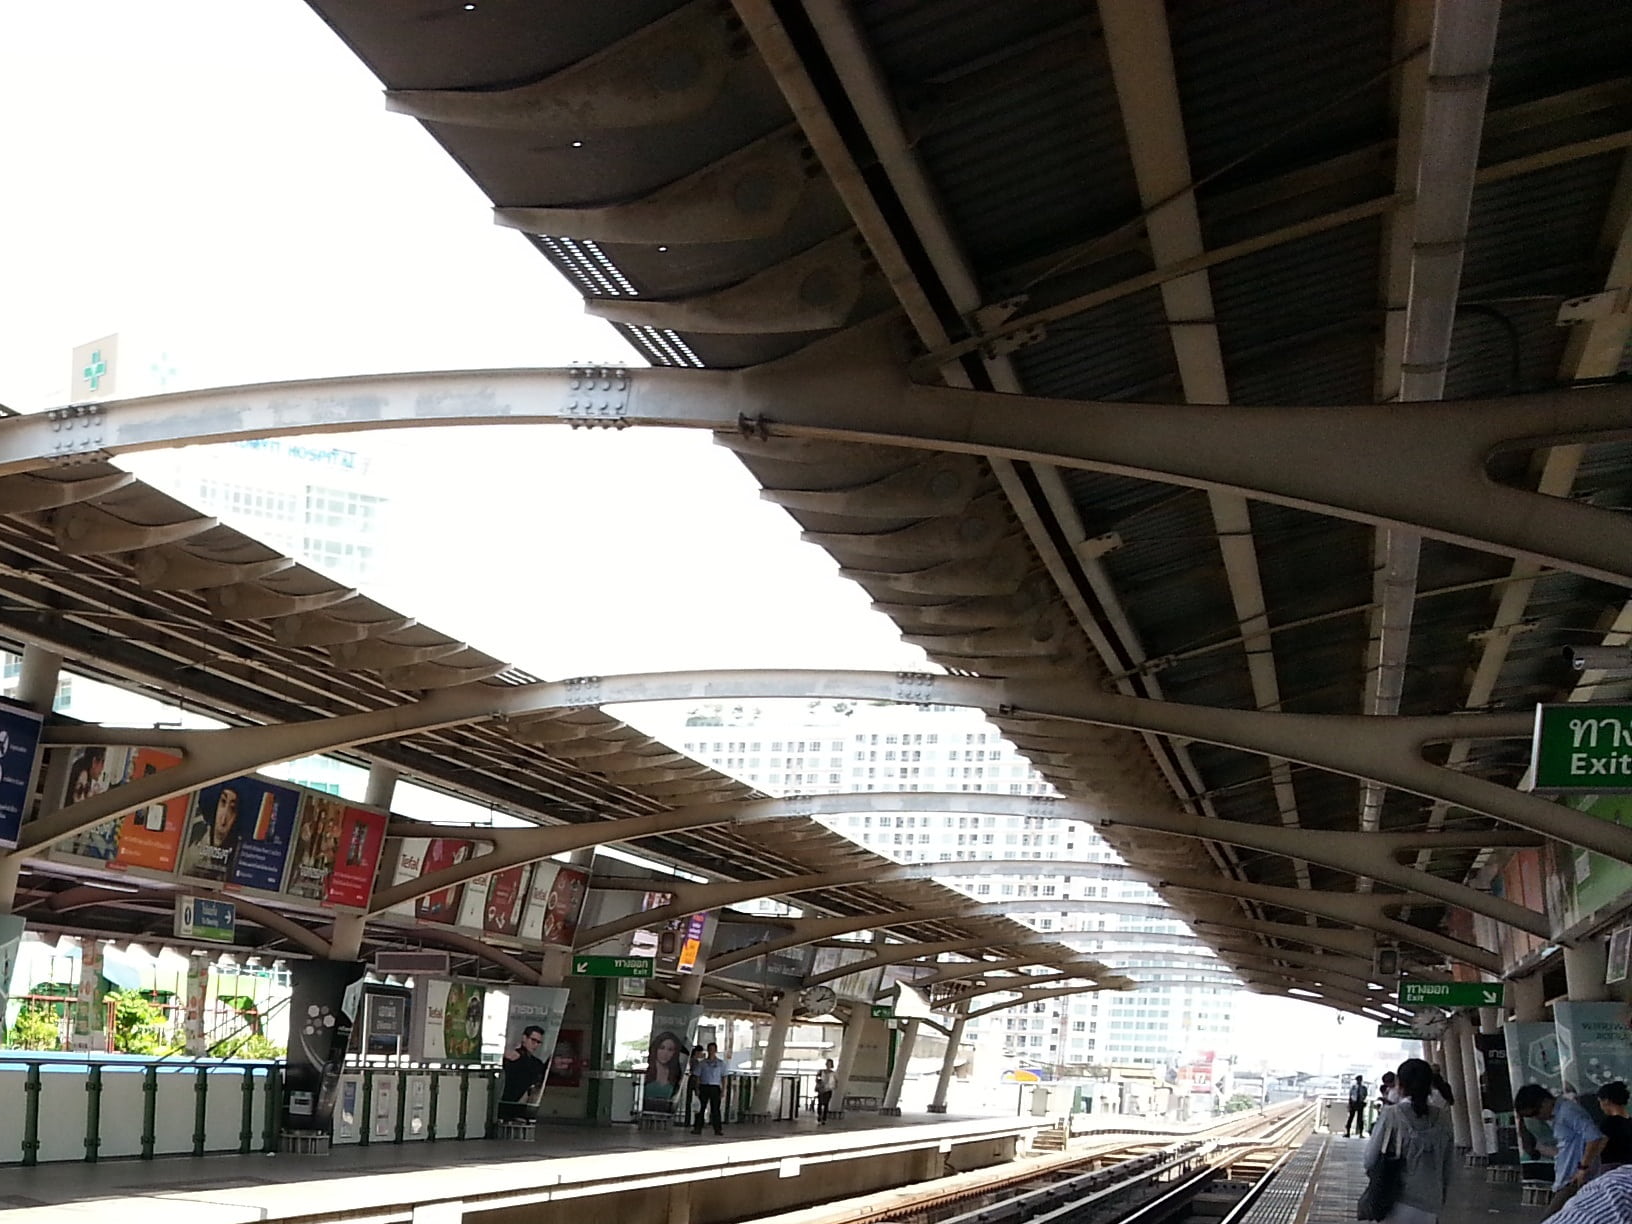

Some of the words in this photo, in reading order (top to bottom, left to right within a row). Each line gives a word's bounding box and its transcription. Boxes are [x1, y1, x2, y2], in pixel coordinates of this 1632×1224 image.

[1570, 751, 1632, 775] Exit
[401, 853, 419, 871] Tefal
[614, 959, 649, 969] ทางออก
[1407, 985, 1450, 995] ทางออก
[1407, 994, 1424, 1002] Exit
